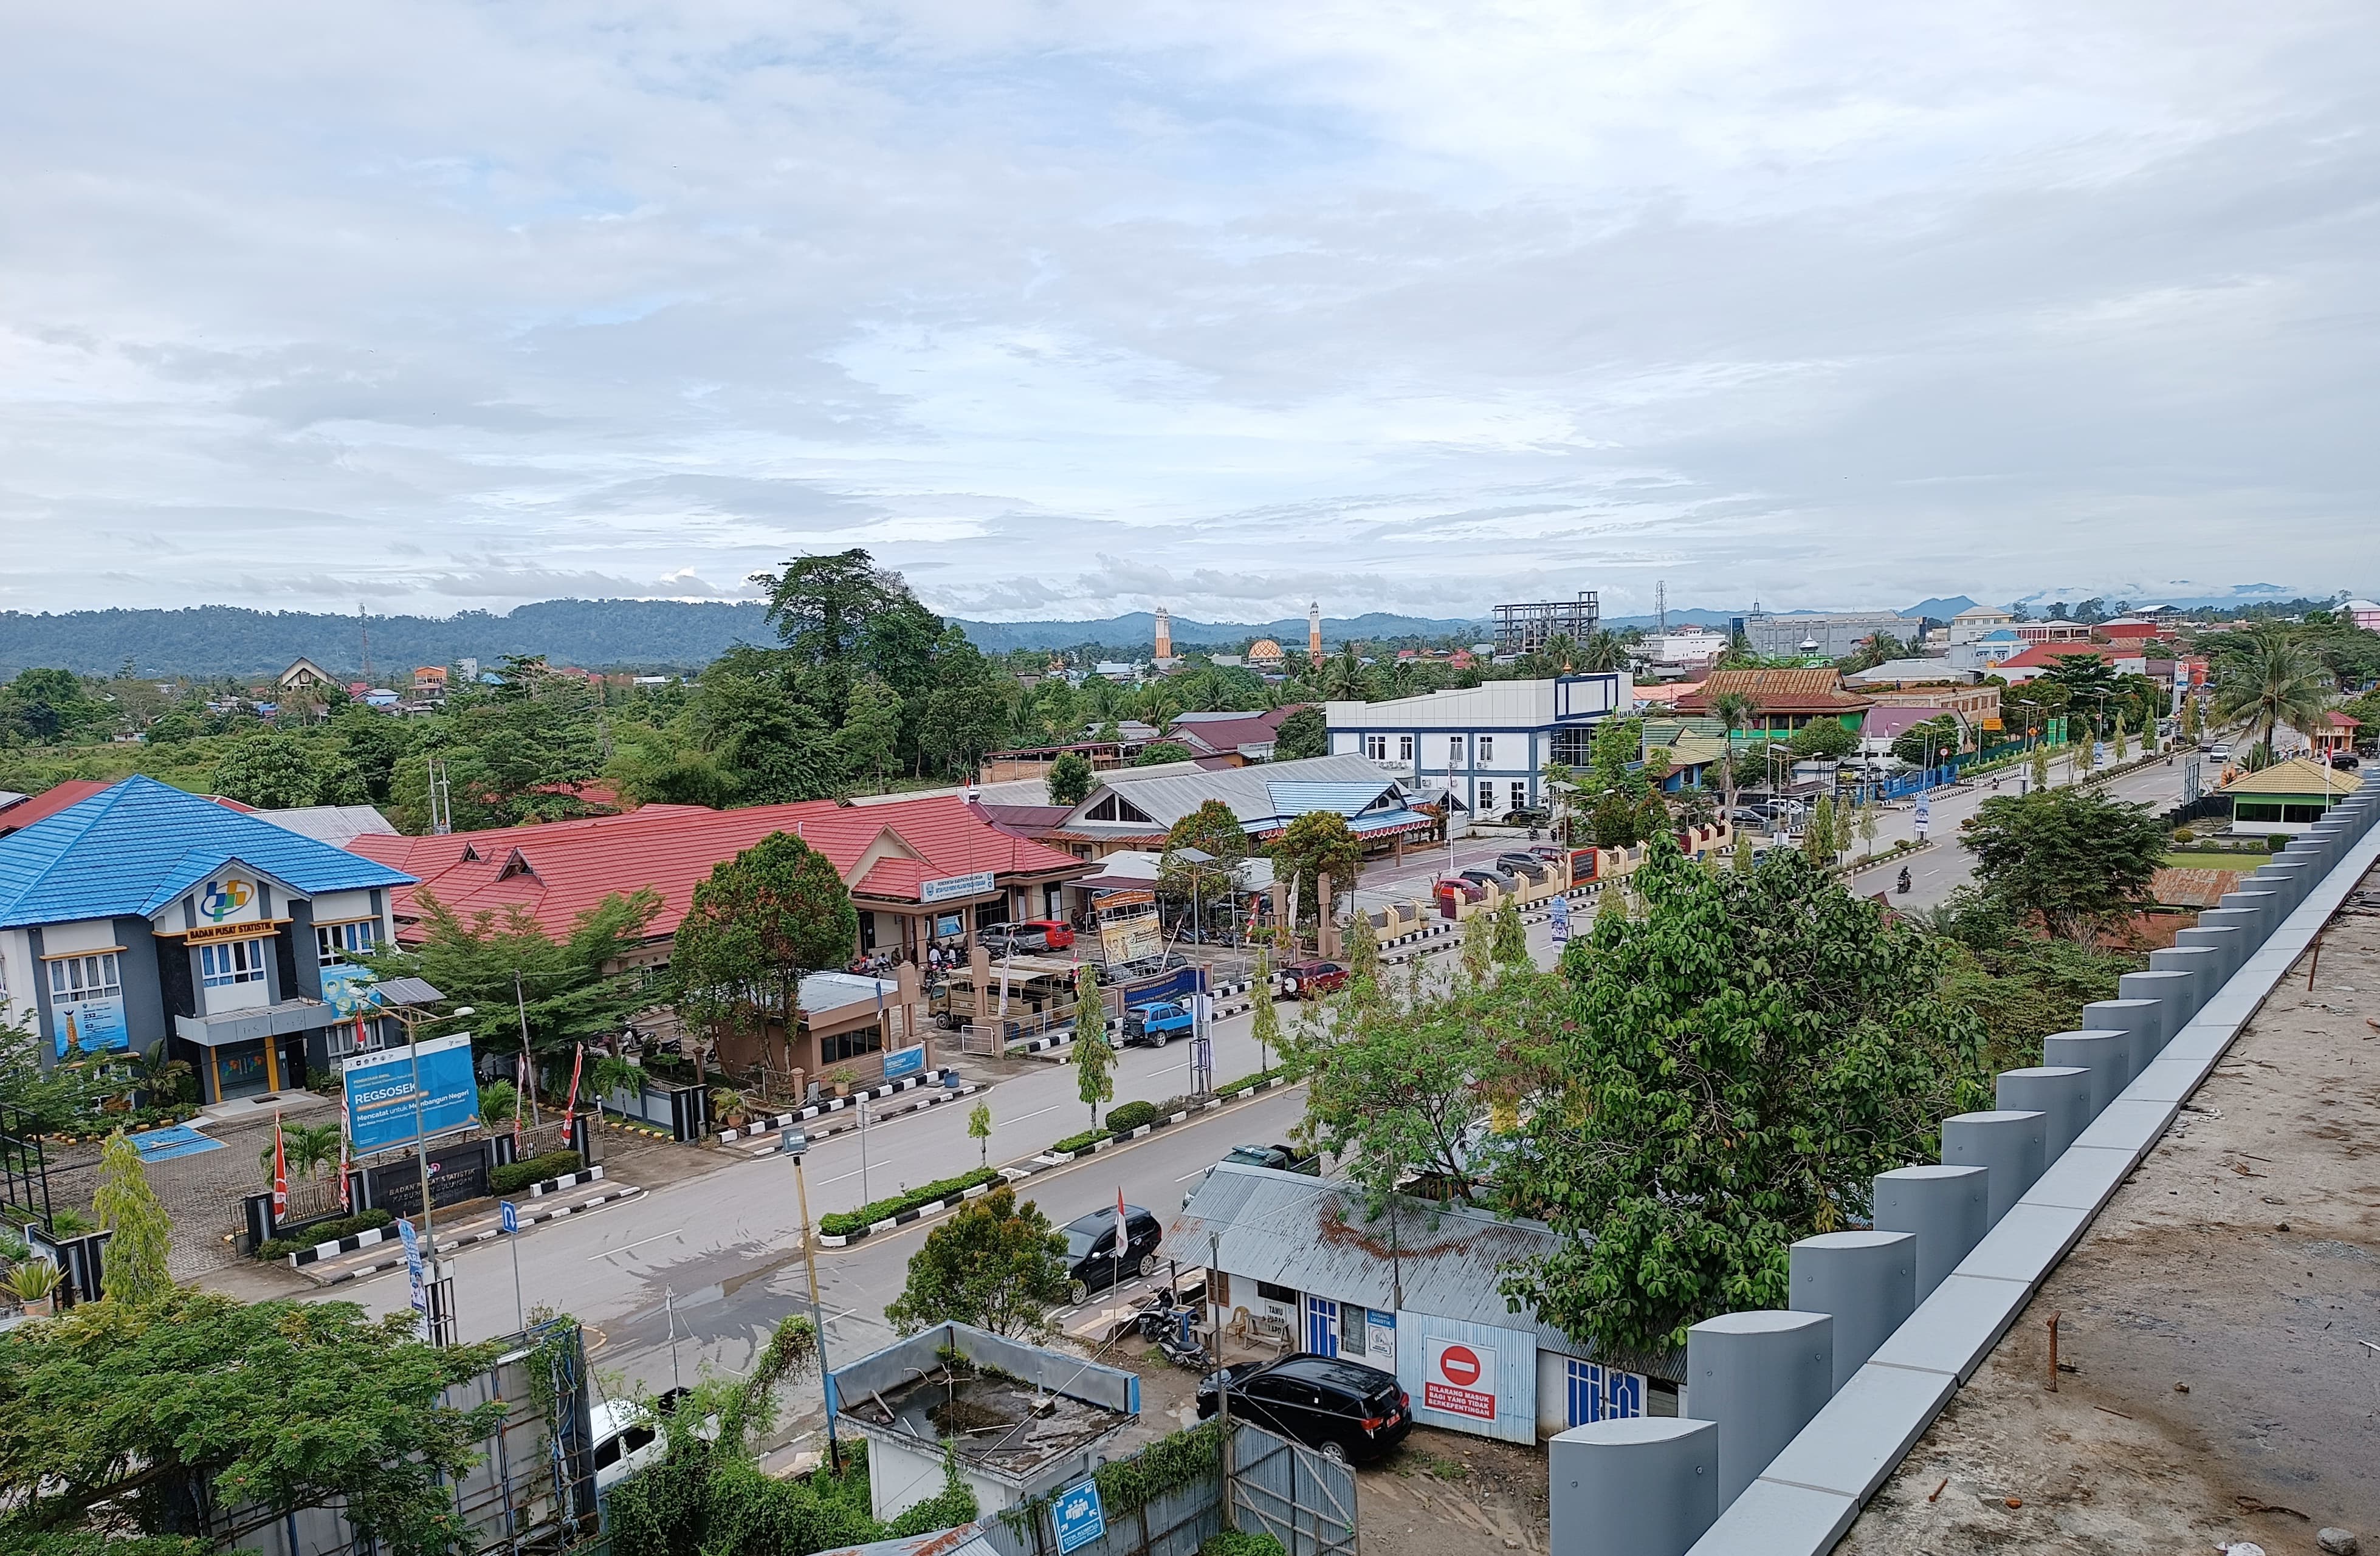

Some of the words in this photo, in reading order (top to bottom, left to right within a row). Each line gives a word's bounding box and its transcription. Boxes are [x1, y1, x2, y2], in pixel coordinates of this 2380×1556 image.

[190, 929, 214, 939] BADAN
[215, 926, 236, 936] PUSAT
[238, 922, 272, 933] STATISTIK
[354, 1075, 378, 1084] PENDATAAN
[355, 1083, 416, 1104] REGSOSEK
[357, 1110, 390, 1122] Mencatat
[390, 1105, 408, 1114] untuk
[449, 1089, 469, 1100] Negeri
[389, 1185, 416, 1196] BADAN
[417, 1177, 439, 1188] PSAT
[441, 1168, 475, 1182] STATISTIK
[1268, 1306, 1283, 1315] TAMU
[1371, 1312, 1390, 1320] GUDANG
[1371, 1317, 1391, 1326] LOGISTIK
[1429, 1385, 1463, 1397] DILARANG
[1465, 1393, 1489, 1403] MASUK
[1429, 1391, 1445, 1400] BAGI
[1447, 1396, 1466, 1404] YANG
[1468, 1399, 1489, 1409] TIDAK
[1428, 1398, 1490, 1416] BERKEPENTINGAN
[1064, 1535, 1077, 1543] TITIK
[1077, 1523, 1099, 1536] KUMPUL
